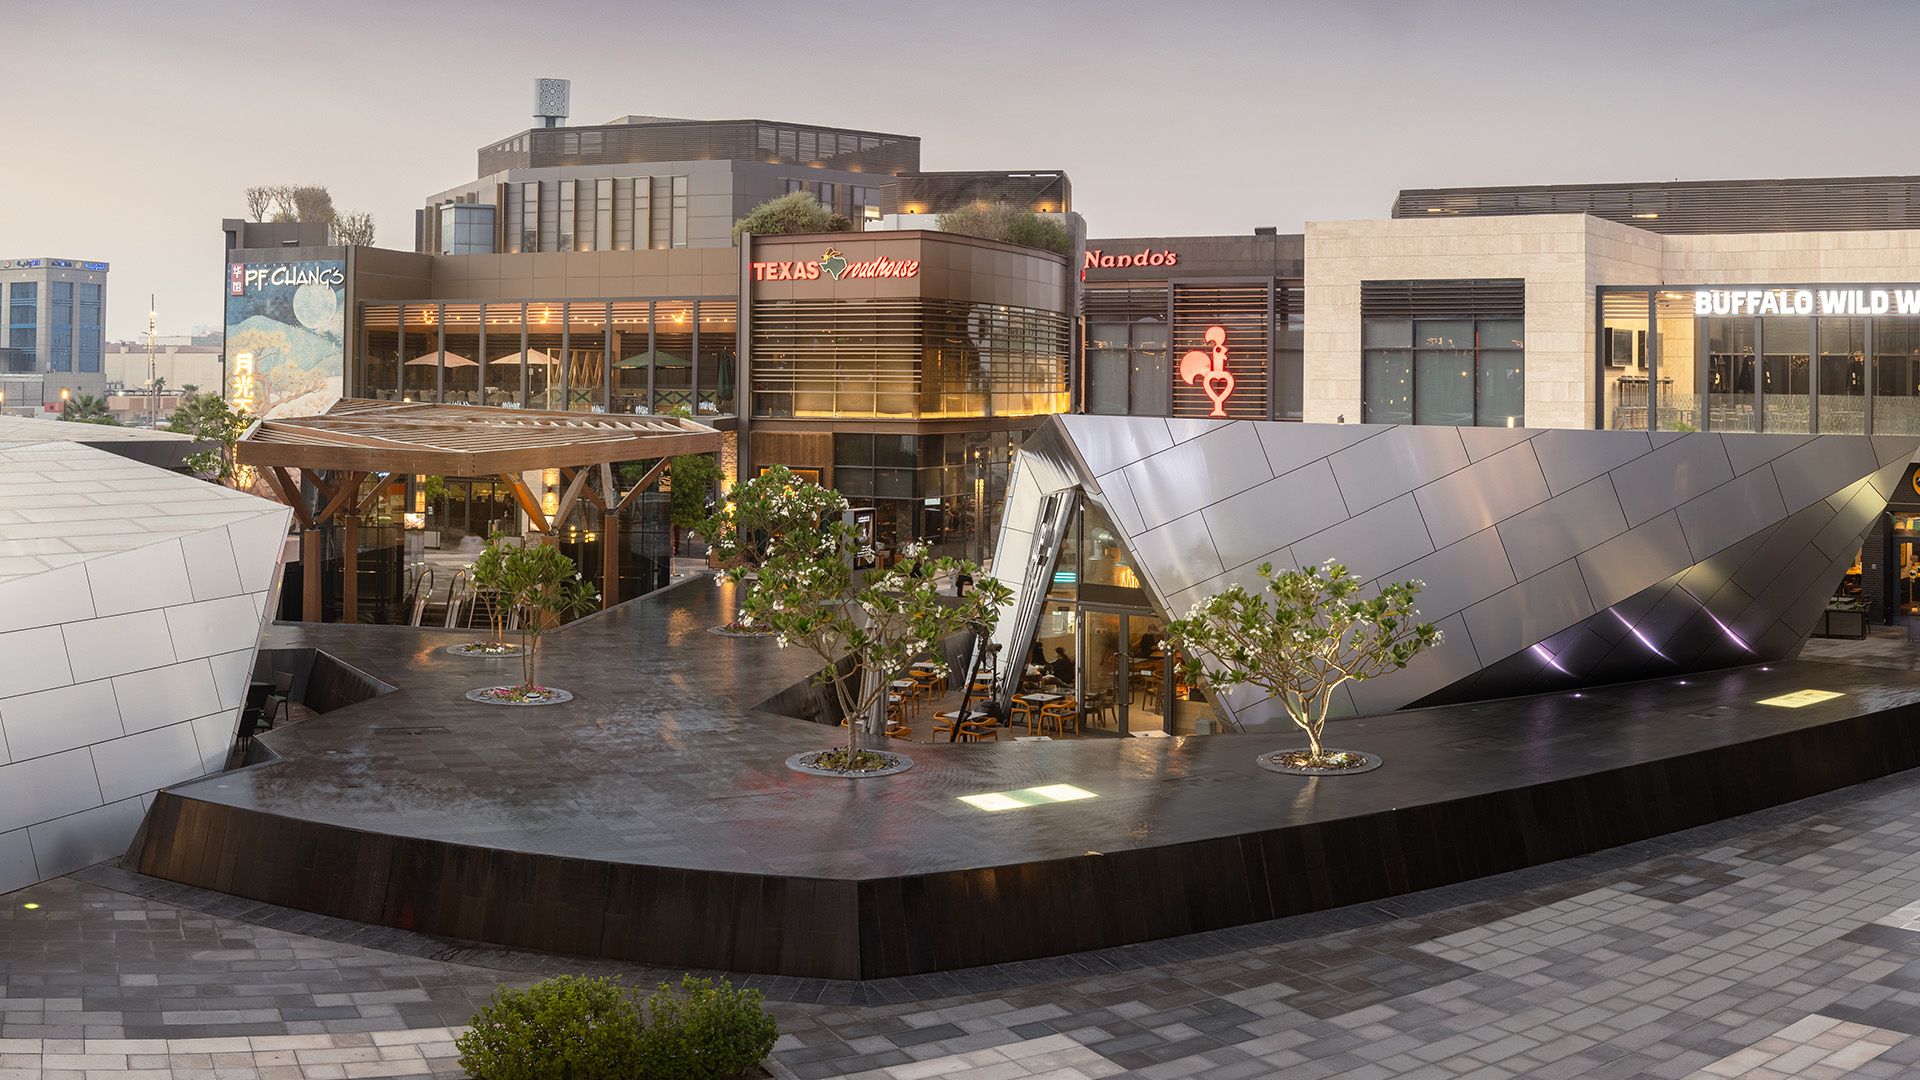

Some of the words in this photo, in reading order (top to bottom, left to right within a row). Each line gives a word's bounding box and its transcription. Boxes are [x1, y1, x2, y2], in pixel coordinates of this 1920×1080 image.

[753, 260, 821, 281] TEXAS
[841, 256, 919, 279] roadhouse
[1084, 248, 1178, 269] Nando's
[245, 269, 269, 291] P.F.
[1695, 290, 1814, 315] BUFFALO
[1819, 290, 1889, 315] WILD
